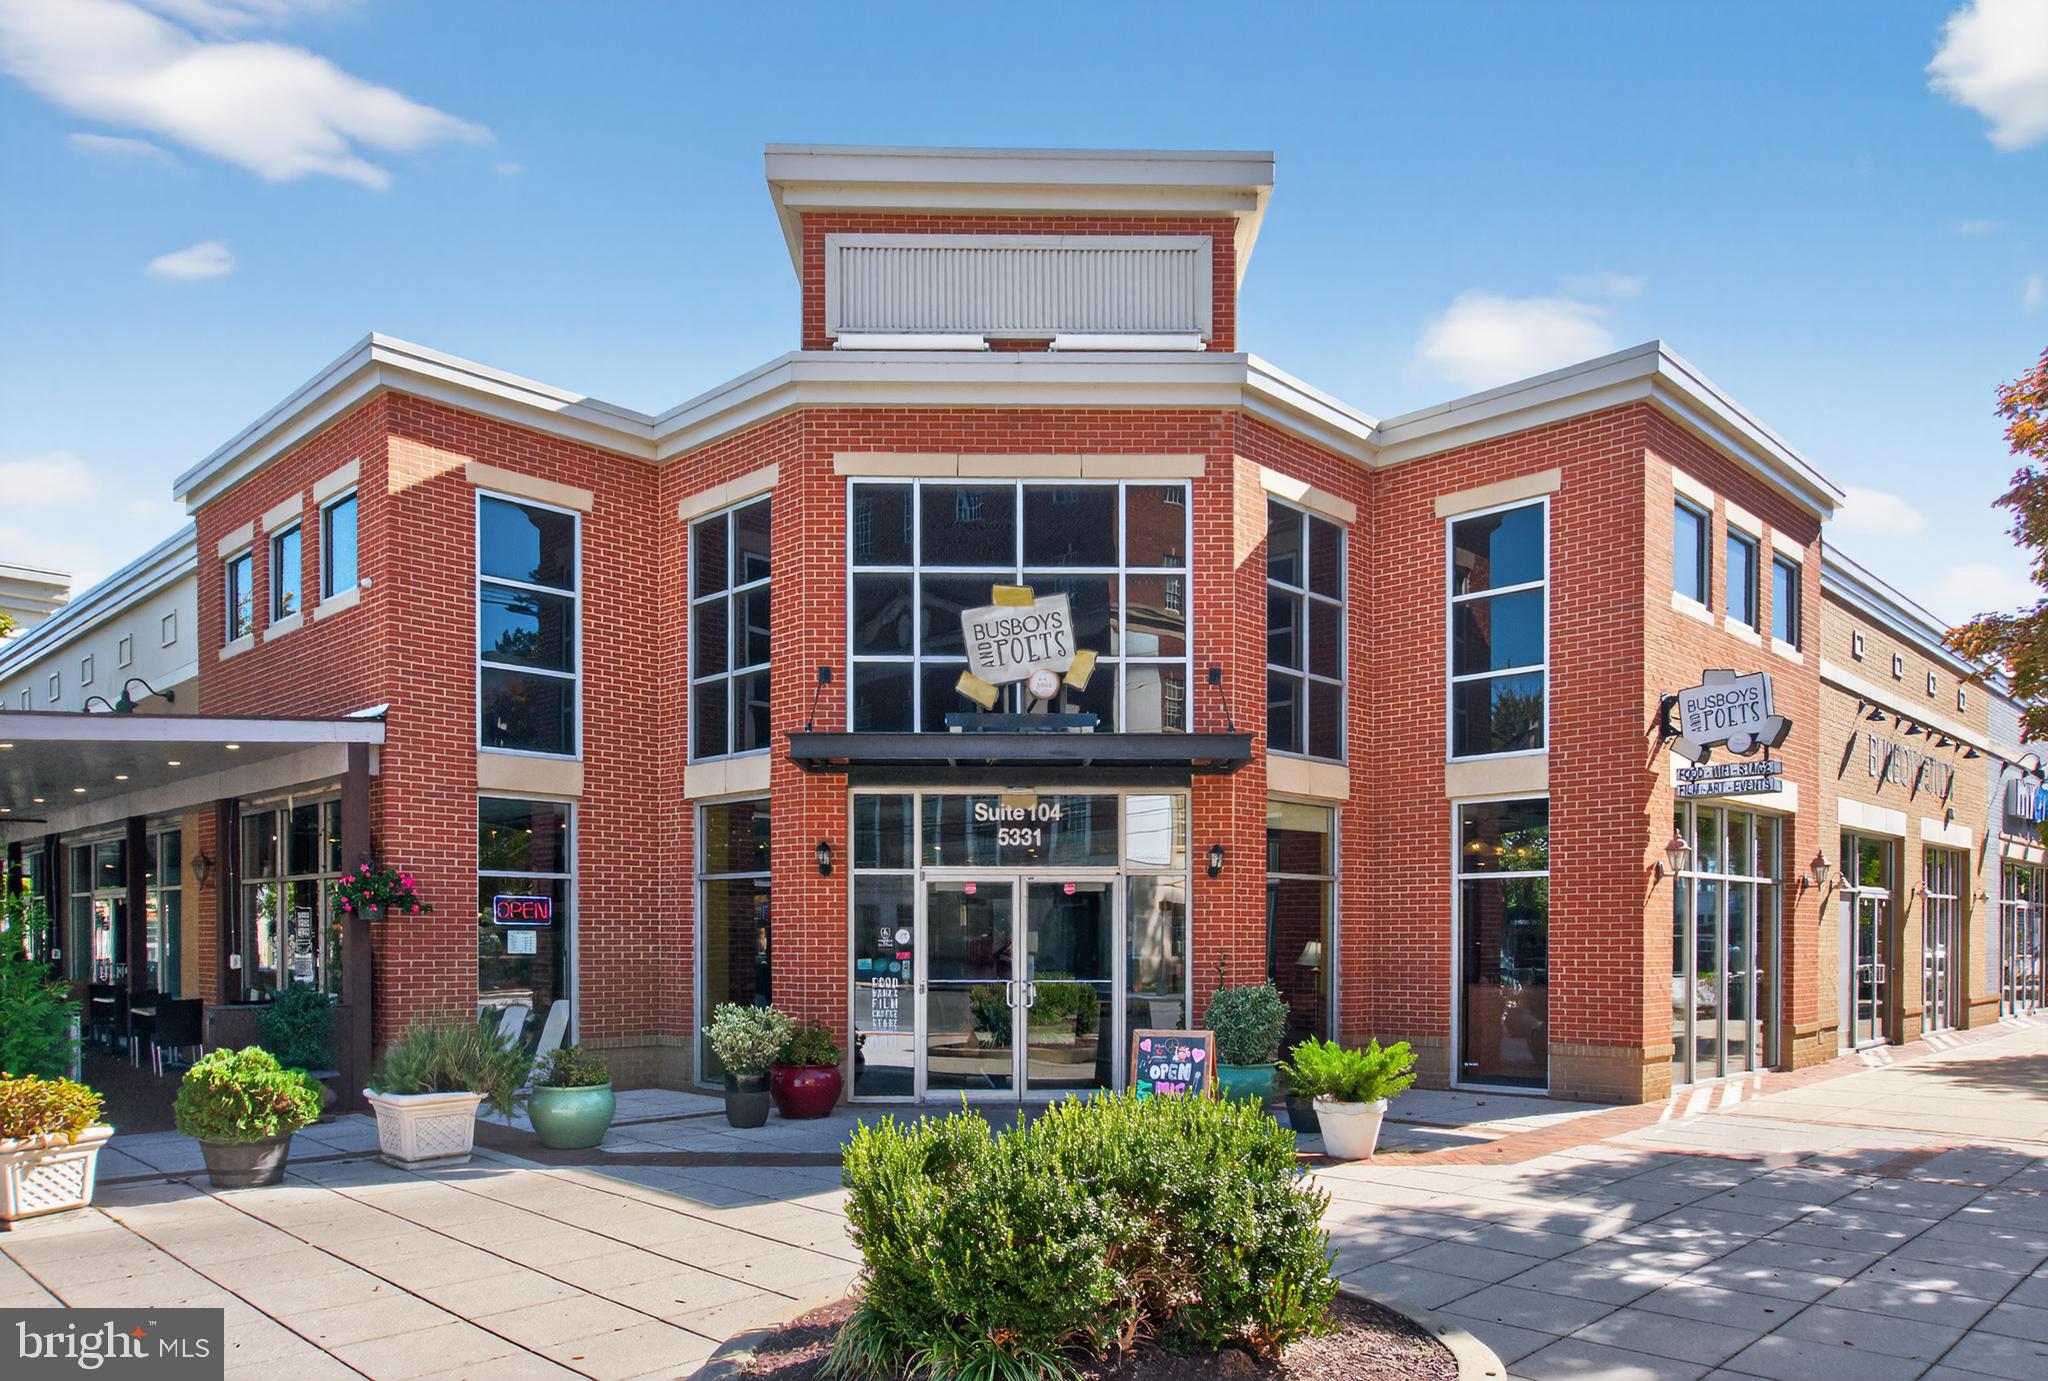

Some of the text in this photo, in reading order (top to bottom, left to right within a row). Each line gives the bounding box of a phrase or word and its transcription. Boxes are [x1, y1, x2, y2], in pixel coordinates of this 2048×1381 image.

[973, 612, 1063, 641] BUSBOYS
[978, 642, 995, 668] AND
[994, 630, 1066, 667] POETS
[1687, 687, 1758, 713] BUSBOYS
[1690, 713, 1701, 732] AND
[1702, 701, 1760, 731] POETS
[1680, 768, 1705, 780] FOOD
[1680, 778, 1771, 796] FILM ART EVENTS
[975, 803, 1063, 821] Suite 104
[998, 828, 1041, 846] 5331
[497, 901, 549, 919] OPEN
[872, 998, 898, 1009] FILM
[1149, 1063, 1192, 1081] OPEN
